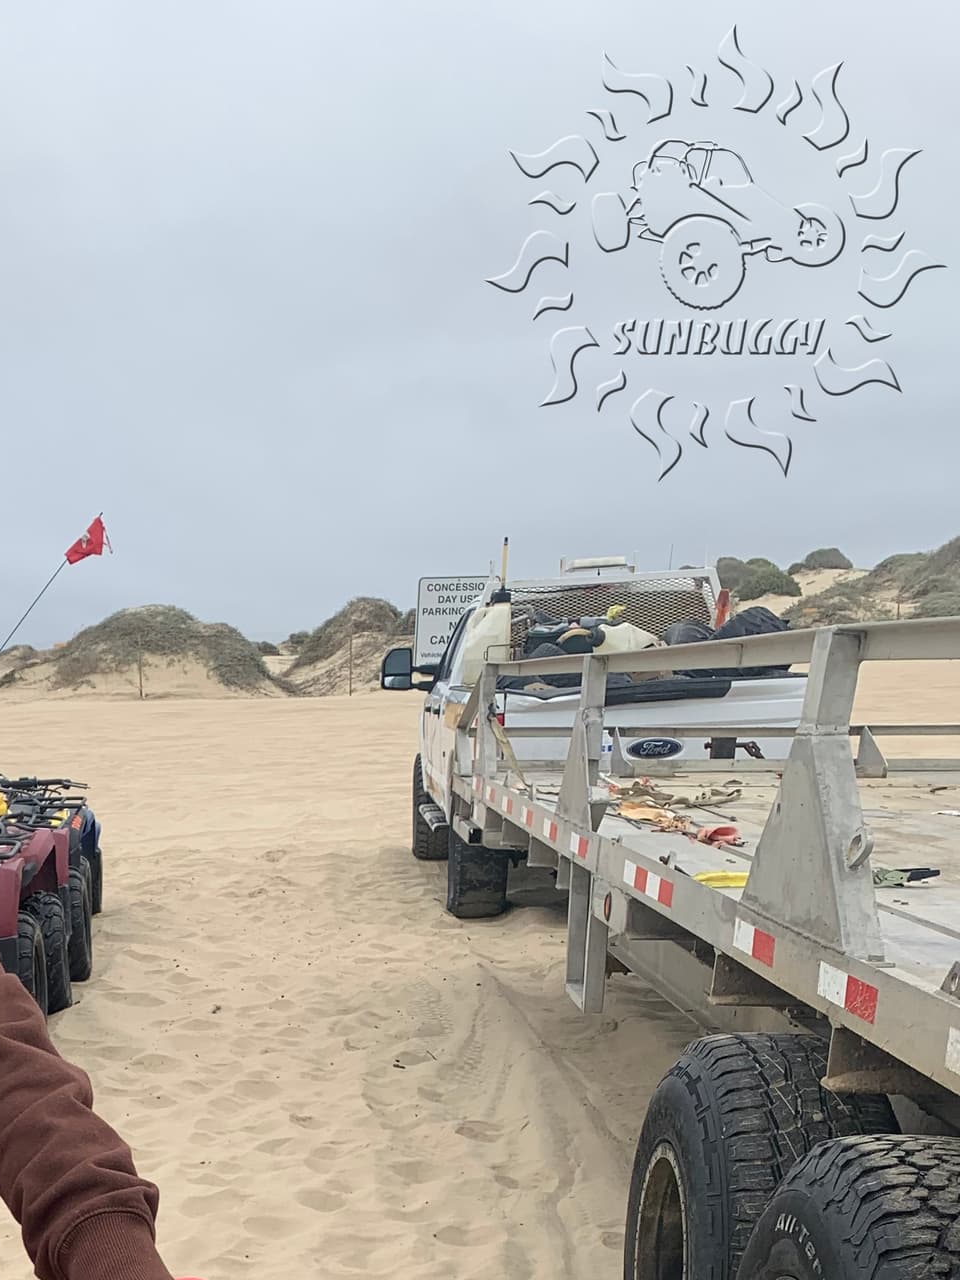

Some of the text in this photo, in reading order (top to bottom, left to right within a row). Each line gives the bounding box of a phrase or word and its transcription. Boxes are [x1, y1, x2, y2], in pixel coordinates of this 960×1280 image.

[426, 582, 485, 592] CONCESSIO
[437, 595, 458, 604] DAY
[639, 741, 671, 755] Ford
